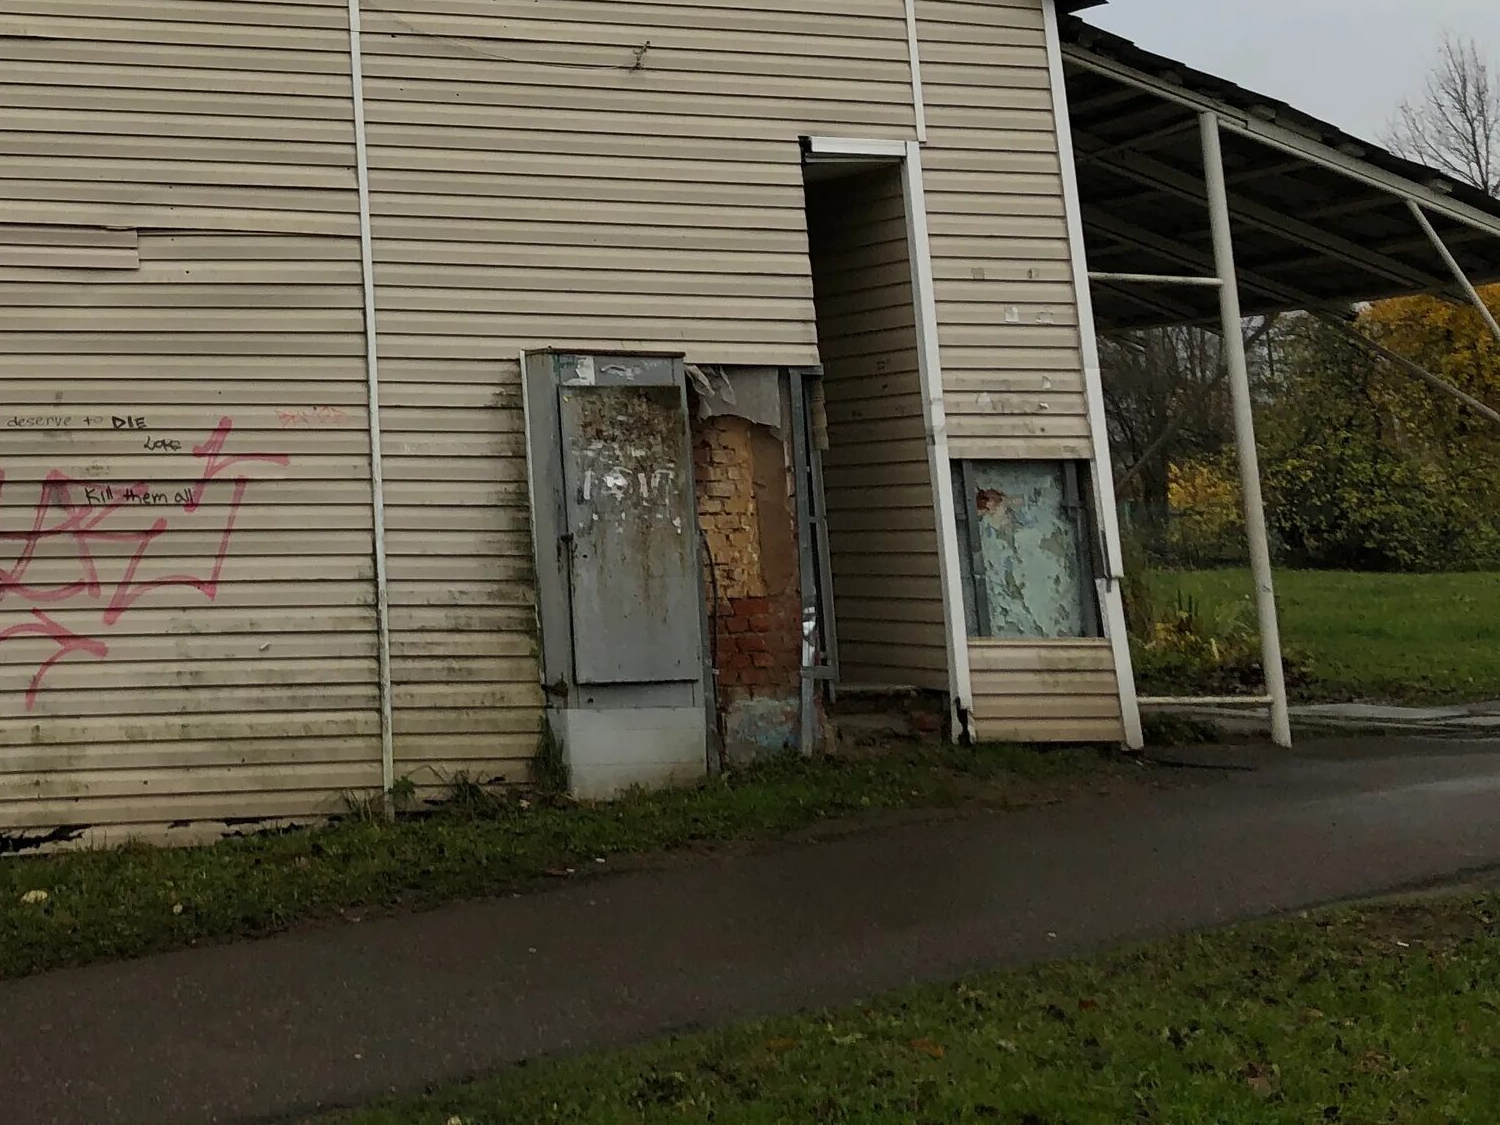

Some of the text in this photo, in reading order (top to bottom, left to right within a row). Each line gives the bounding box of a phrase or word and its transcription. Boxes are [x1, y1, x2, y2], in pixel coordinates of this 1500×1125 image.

[7, 416, 72, 428] deserve
[111, 416, 147, 429] DIE
[123, 487, 167, 504] them
[174, 487, 194, 504] all
